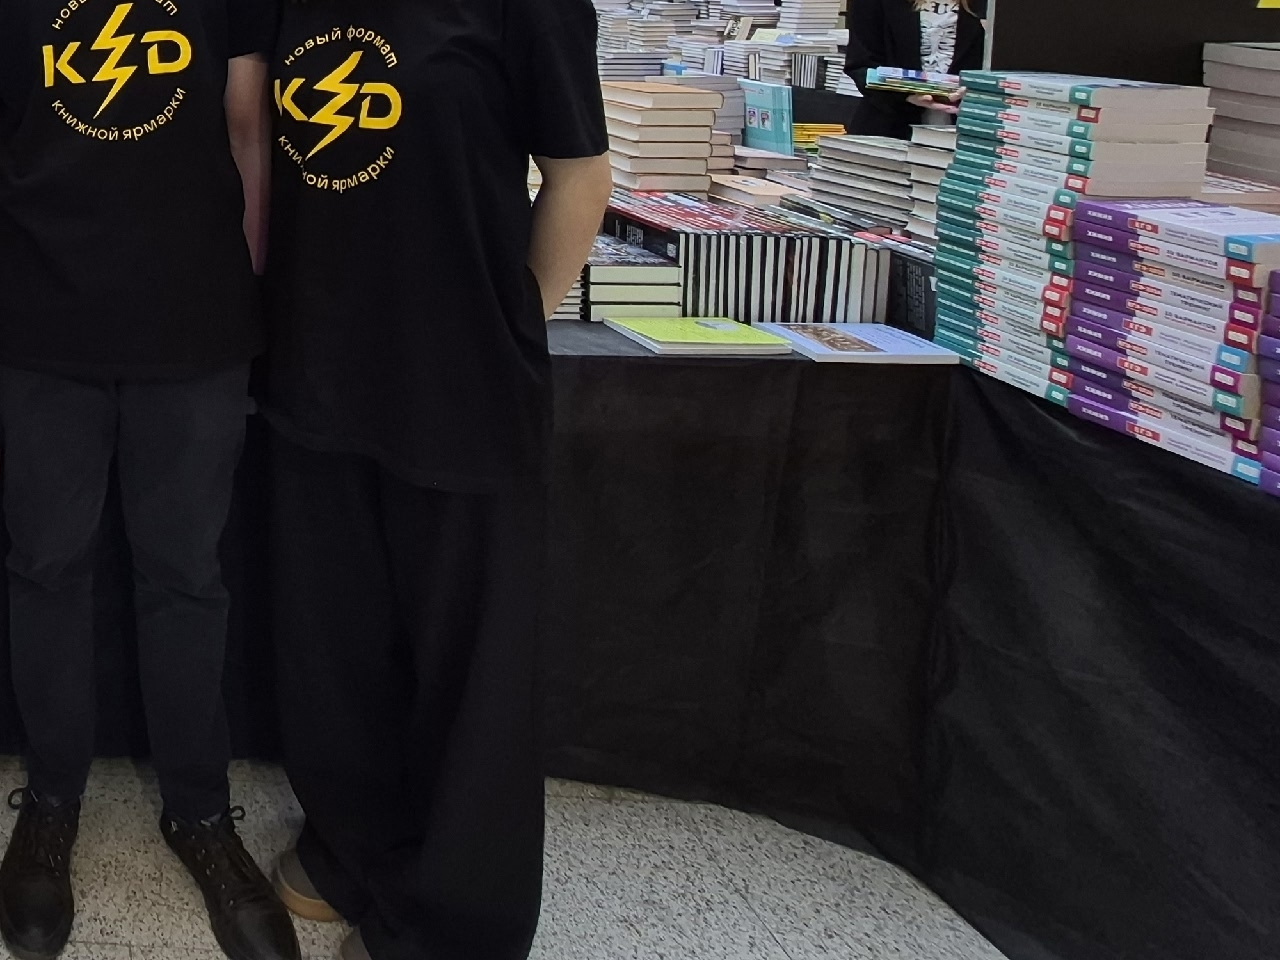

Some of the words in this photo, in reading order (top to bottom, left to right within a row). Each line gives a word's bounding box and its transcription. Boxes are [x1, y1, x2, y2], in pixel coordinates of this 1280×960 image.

[284, 27, 341, 66] новый
[346, 24, 398, 69] формат
[51, 99, 119, 140] книжной
[122, 87, 187, 141] ярмарки
[332, 146, 395, 194] ярмарки
